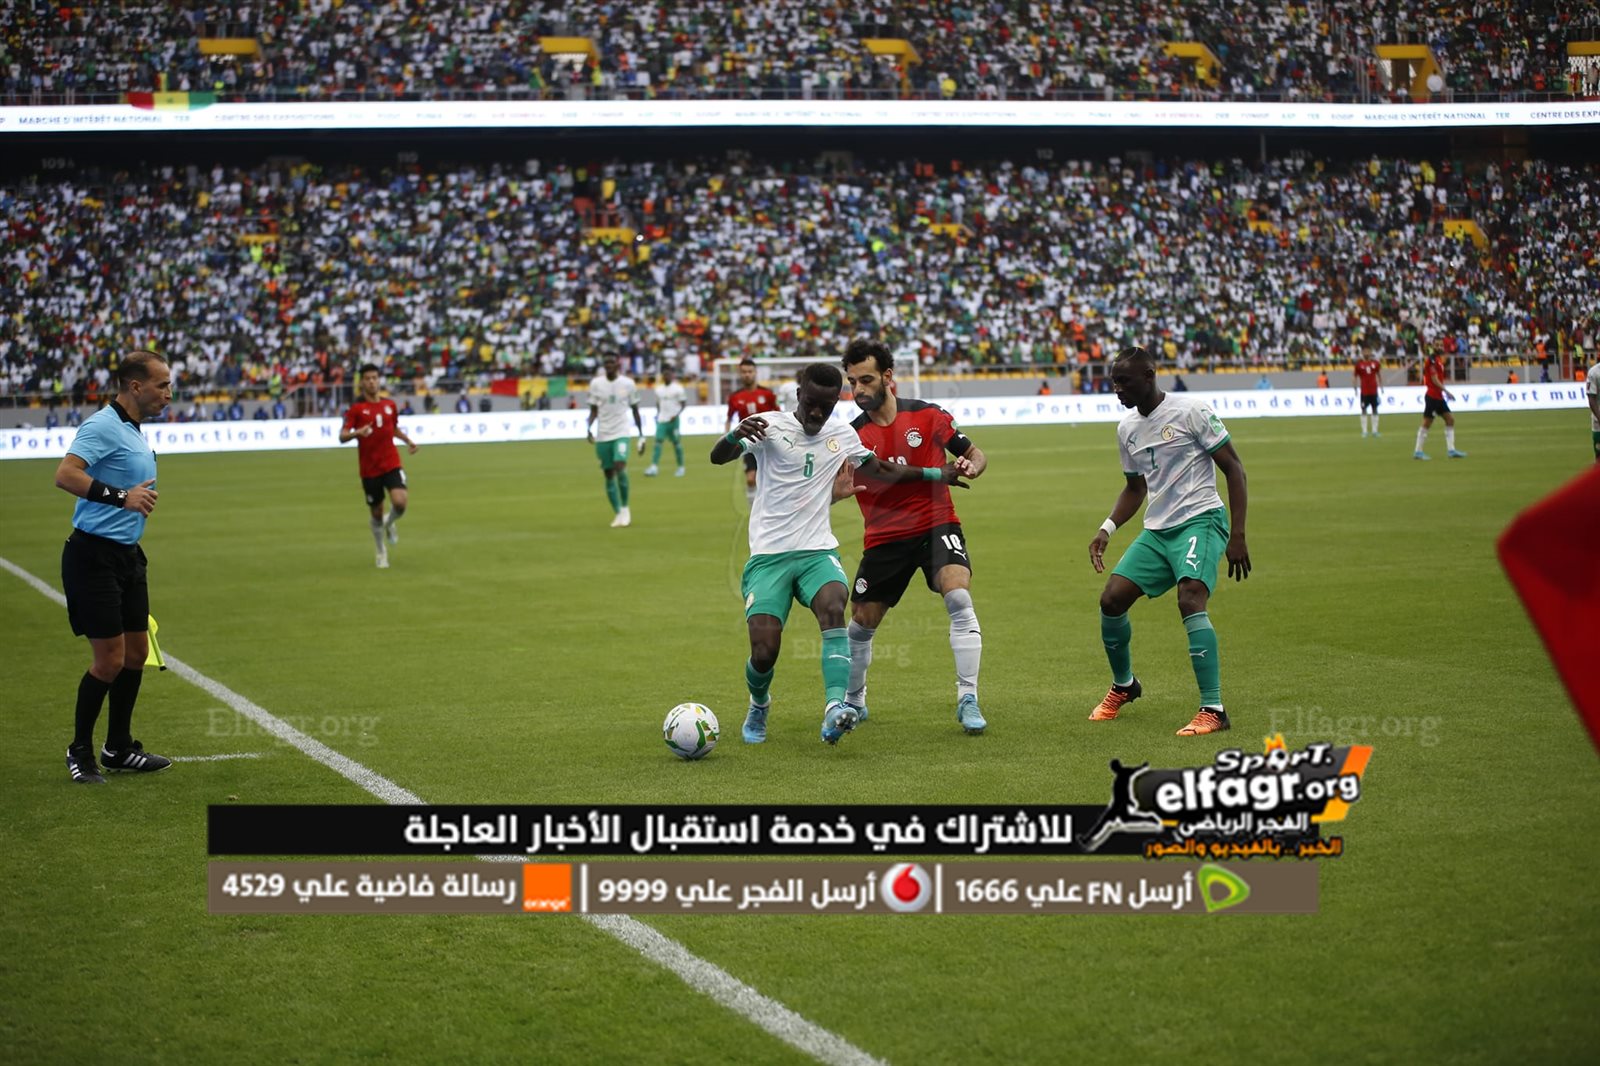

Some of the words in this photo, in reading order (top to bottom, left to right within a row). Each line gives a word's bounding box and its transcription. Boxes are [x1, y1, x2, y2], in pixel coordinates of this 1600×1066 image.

[1443, 112, 1487, 121] NATIONAL
[1529, 111, 1562, 120] CENTRE
[1563, 110, 1580, 120] DES
[1269, 395, 1293, 409] de
[1495, 389, 1539, 402] Port
[1036, 401, 1083, 414] Port
[11, 435, 65, 450] Port
[279, 426, 306, 441] de
[802, 452, 815, 479] 5
[941, 533, 963, 551] 10
[1185, 535, 1198, 560] 2
